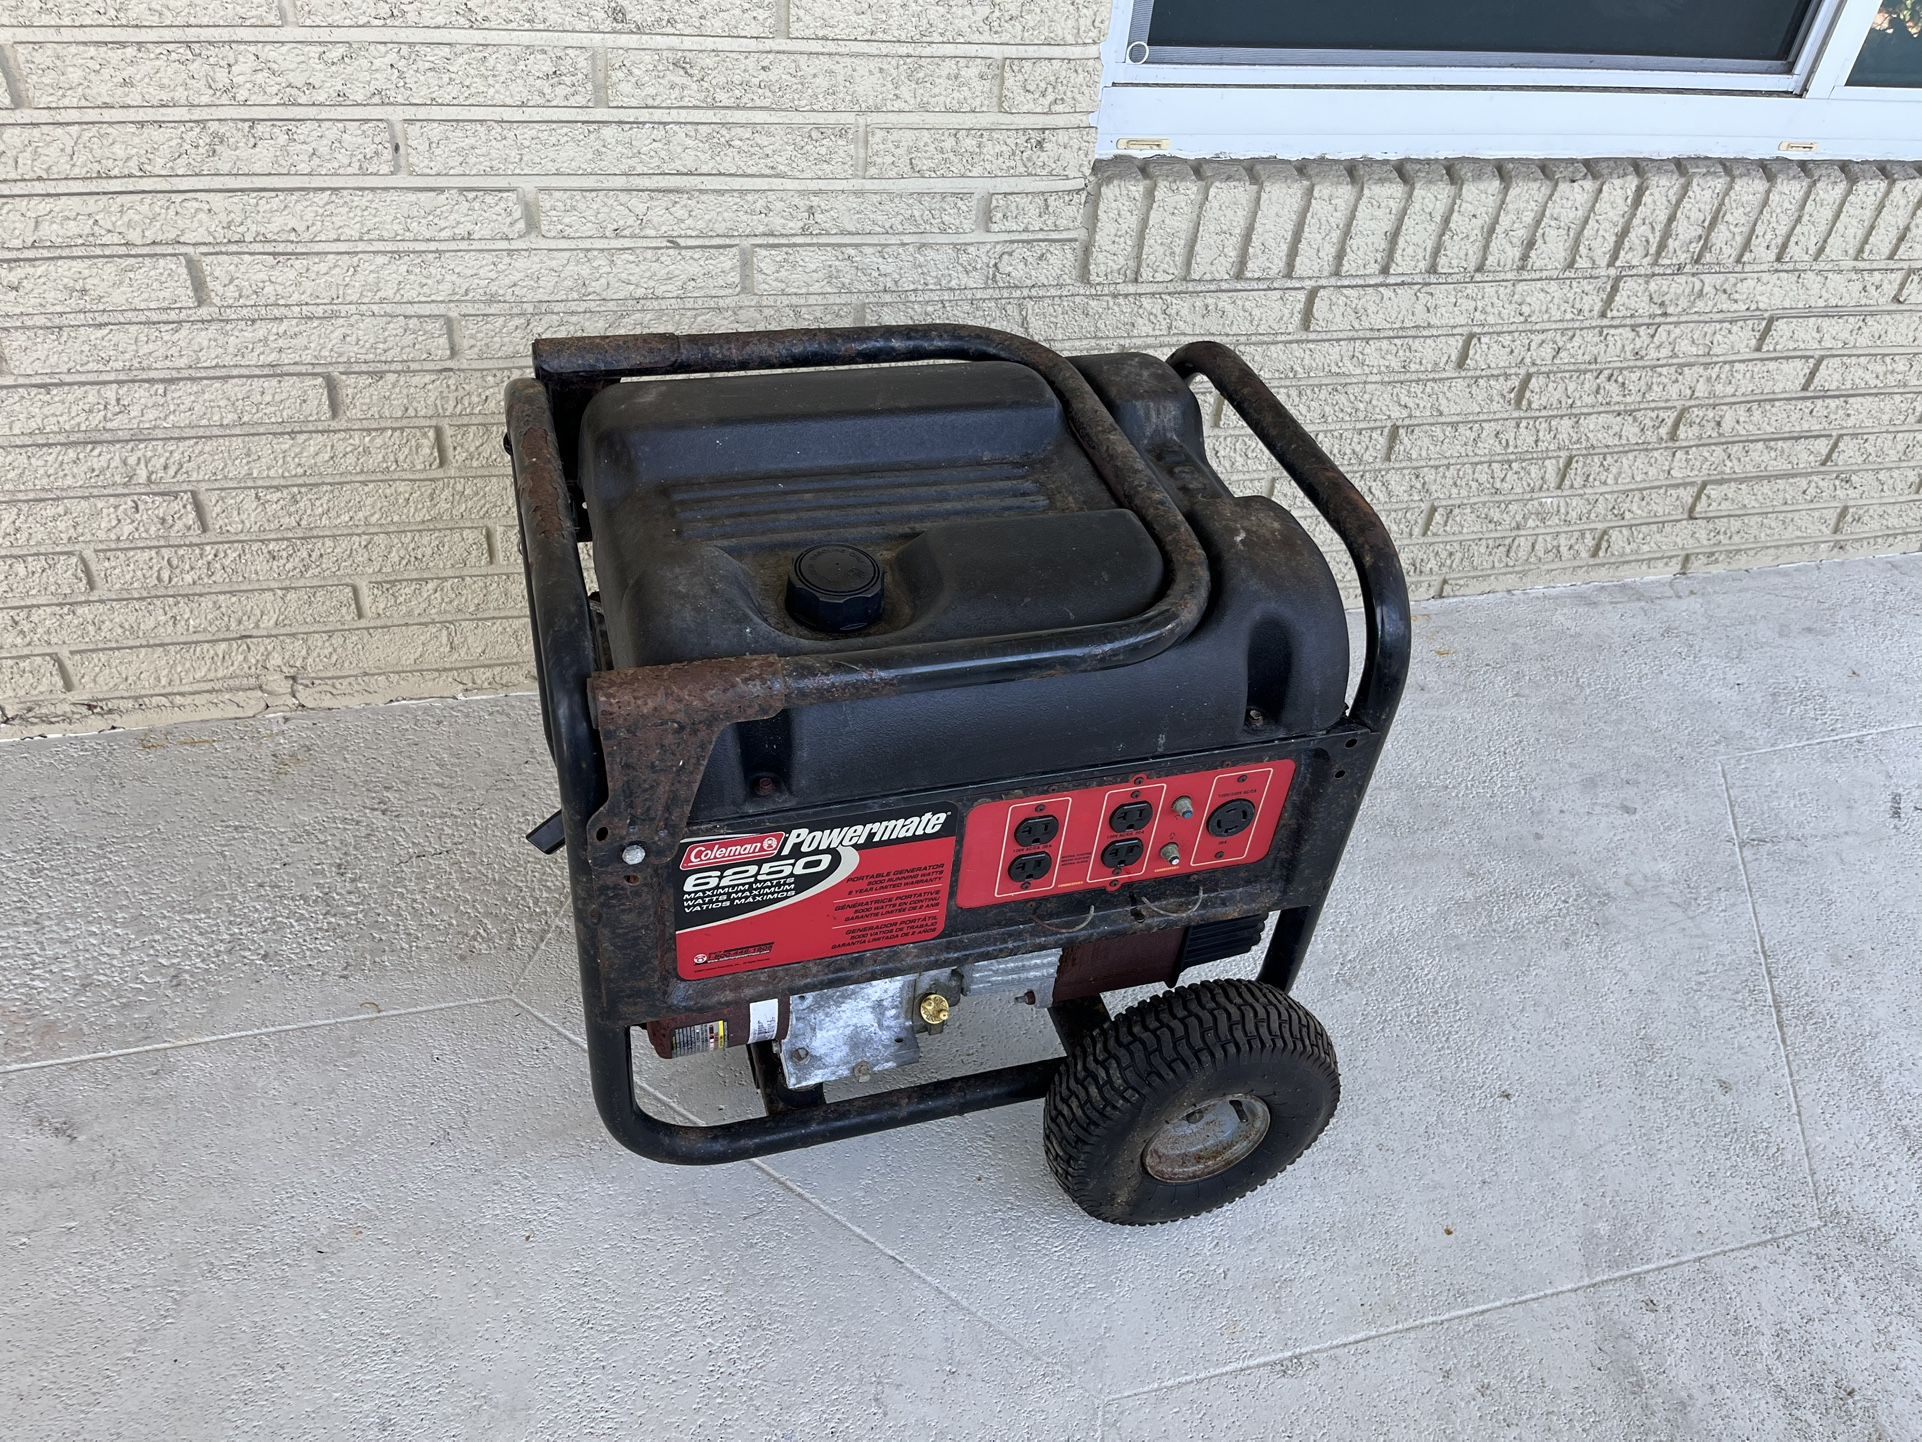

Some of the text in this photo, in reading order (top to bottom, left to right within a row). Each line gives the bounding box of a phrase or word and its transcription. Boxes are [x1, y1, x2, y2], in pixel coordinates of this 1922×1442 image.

[780, 811, 948, 856] Powermate
[690, 842, 761, 863] Coleman
[683, 854, 832, 892] 6250
[846, 863, 945, 884] PORTABLE GENERATOR
[867, 869, 944, 887] 5000 RUNNING WATTS
[683, 877, 795, 900] MAXIMUM WATTS
[683, 884, 795, 907] WATTS MAXIMUM
[855, 887, 874, 895] YEAR
[874, 882, 903, 891] LIMITED
[903, 876, 943, 886] WARRANTY
[894, 889, 941, 902] PORTATIVE
[684, 890, 796, 913] VATIOS MÁXIMOS
[854, 907, 873, 915] 5000
[873, 902, 897, 911] WATTS
[909, 896, 940, 906] CONTINU
[844, 911, 880, 922] GARANTIE
[845, 922, 898, 936] GENERADOR
[850, 933, 869, 941] 5000
[869, 929, 894, 938] VATIOS
[906, 921, 937, 931] TRABAJO
[867, 933, 899, 944] LIMITADA
